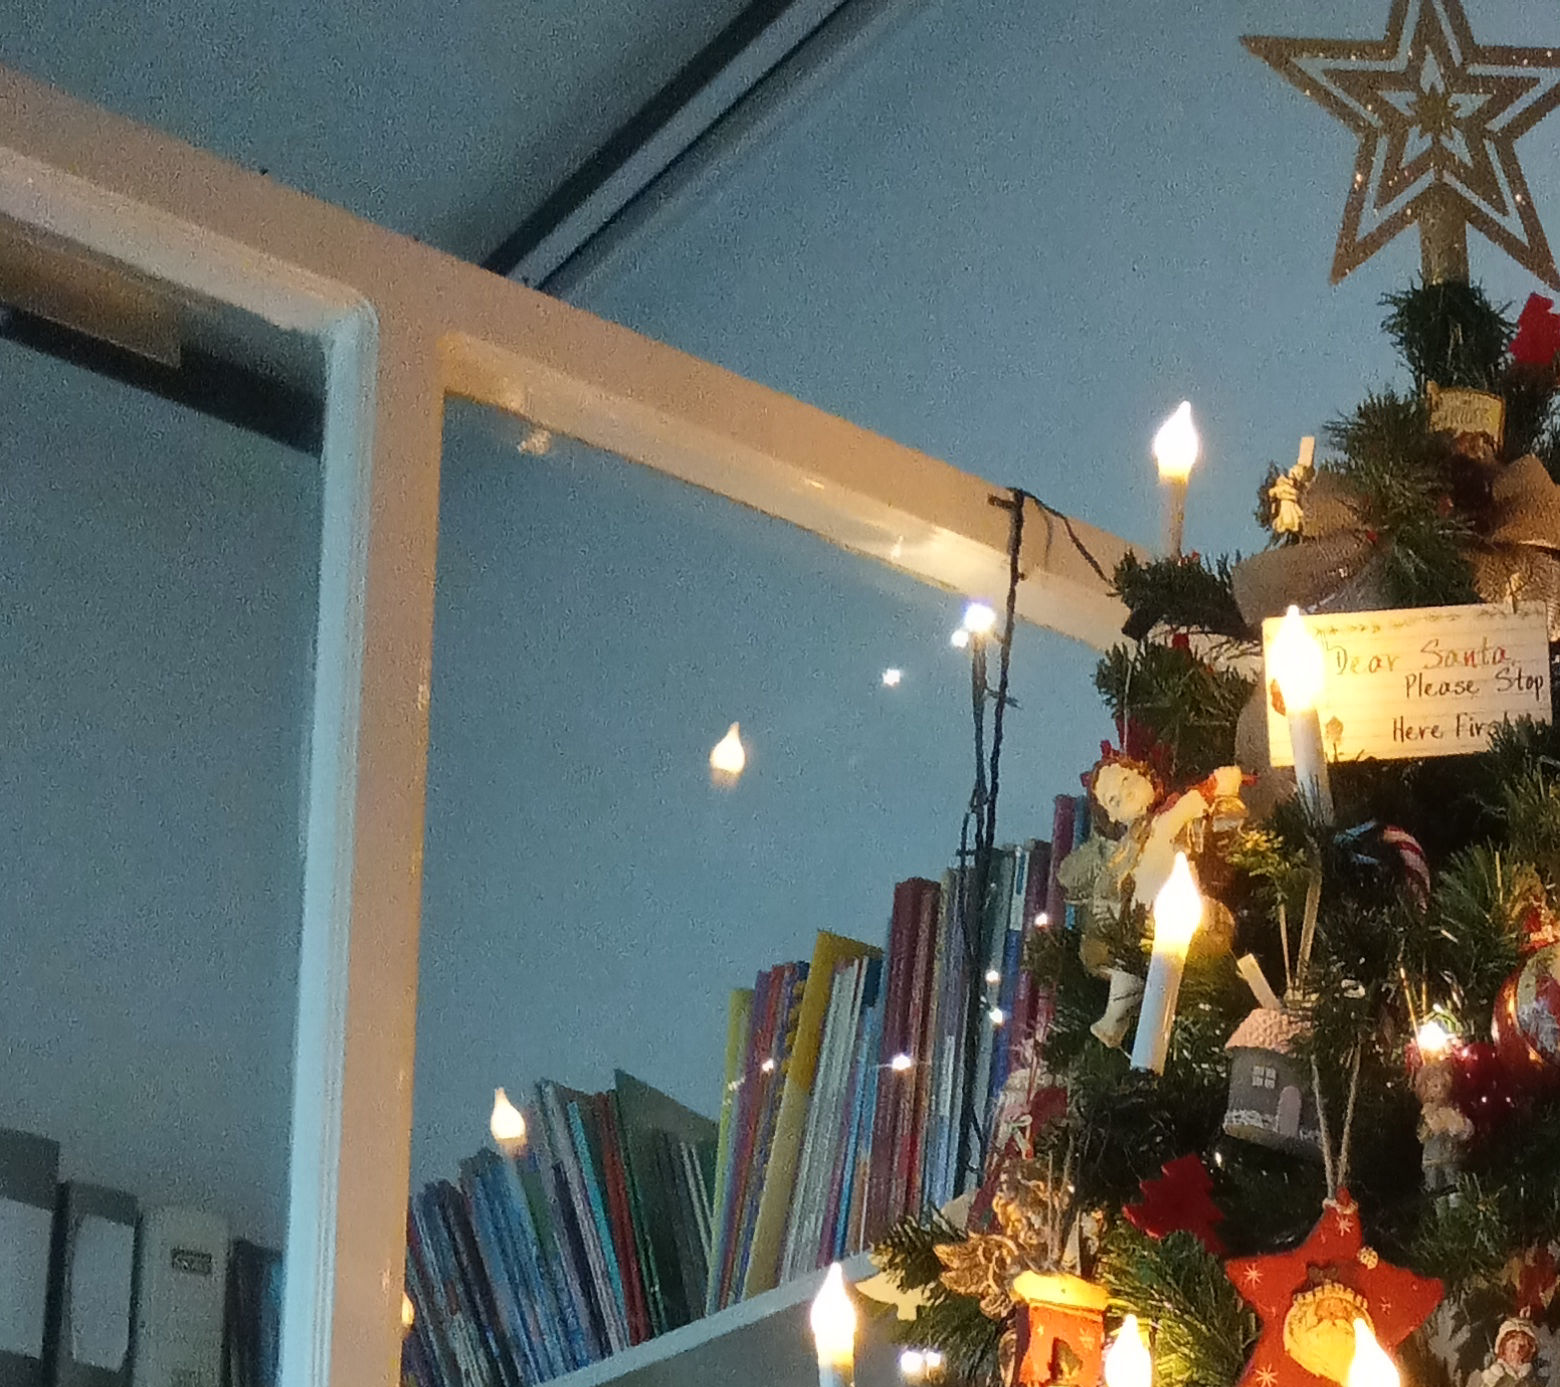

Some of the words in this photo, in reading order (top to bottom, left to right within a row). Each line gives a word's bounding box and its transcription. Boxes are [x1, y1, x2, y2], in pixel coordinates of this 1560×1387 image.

[1335, 645, 1399, 676] Dear
[1404, 672, 1480, 699] Please
[1494, 666, 1544, 702] Stop
[1392, 715, 1445, 743] Here
[1455, 711, 1504, 740] Fir
